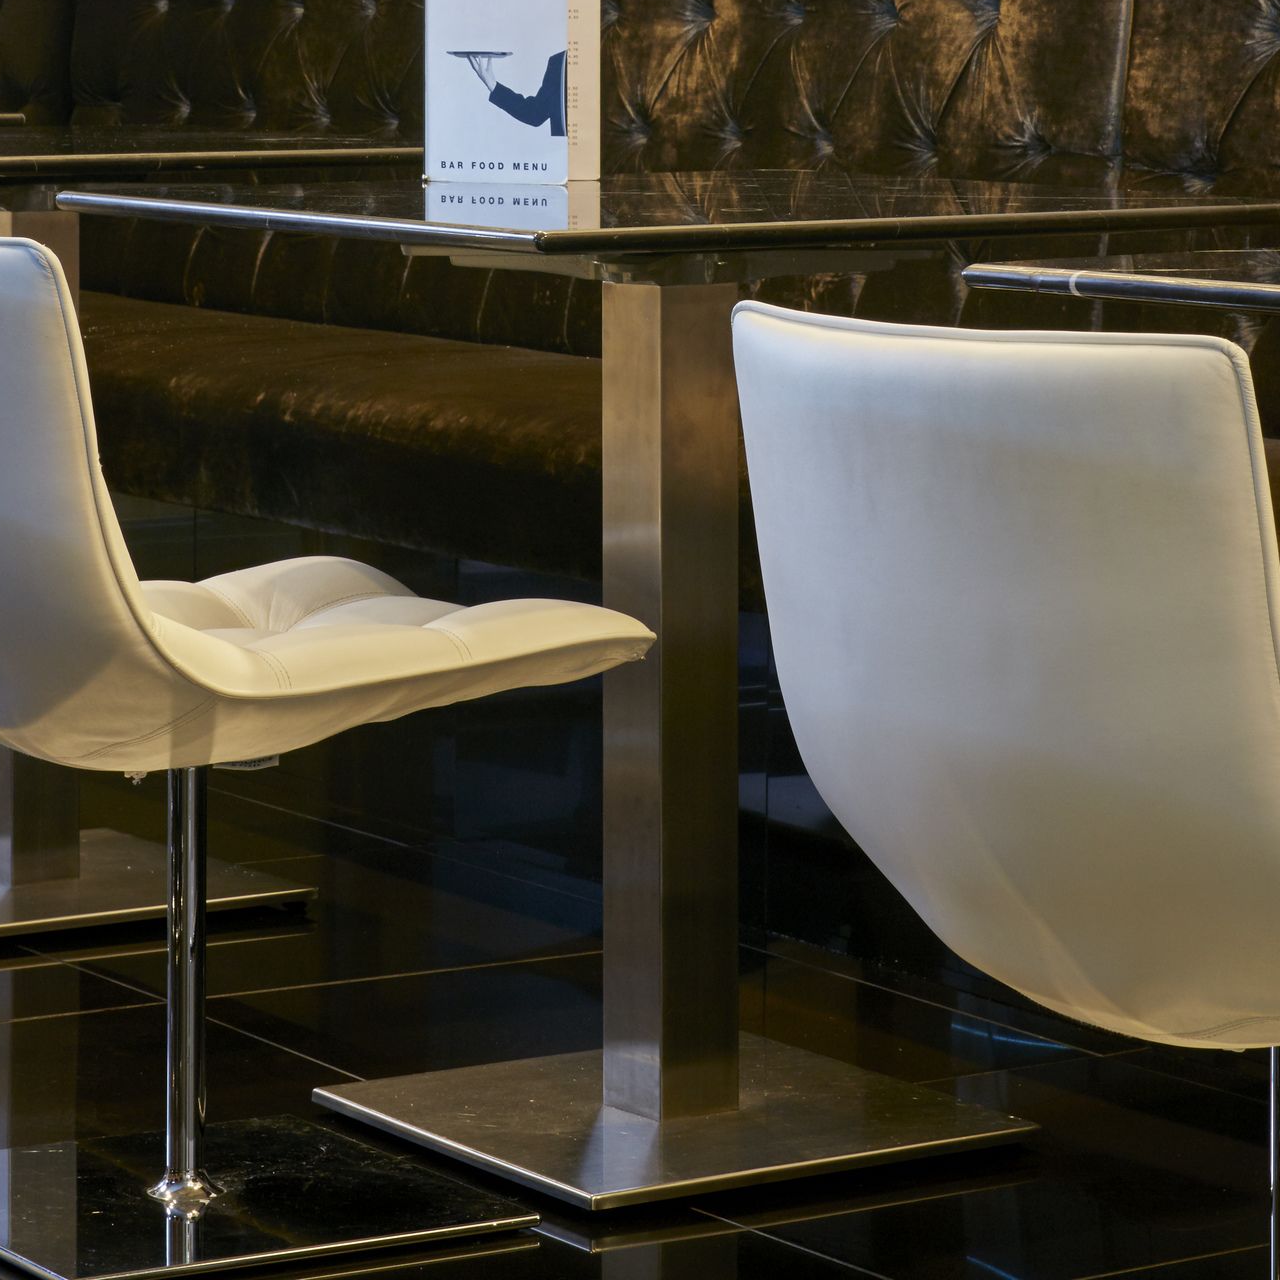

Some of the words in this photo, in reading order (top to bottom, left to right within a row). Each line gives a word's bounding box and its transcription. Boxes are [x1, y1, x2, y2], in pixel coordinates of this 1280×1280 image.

[439, 160, 464, 171] BAR
[471, 160, 505, 172] FOOD
[512, 161, 549, 172] MENU
